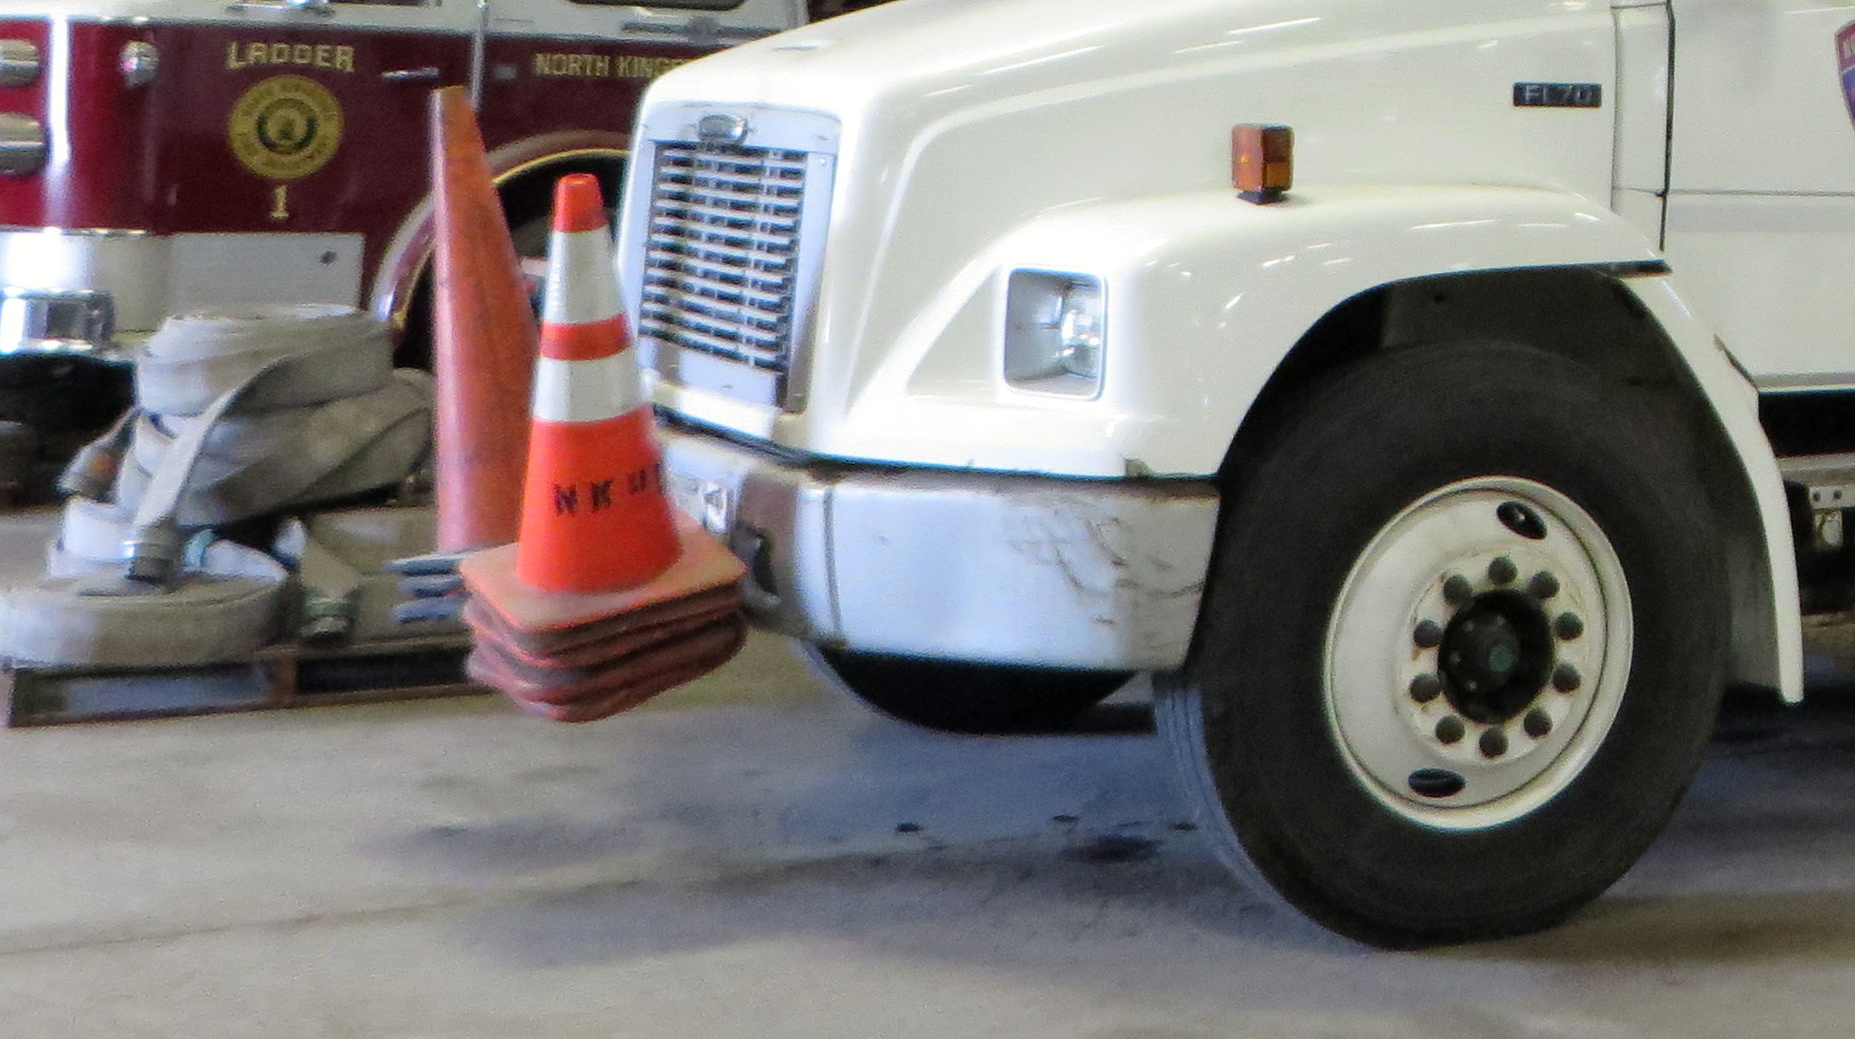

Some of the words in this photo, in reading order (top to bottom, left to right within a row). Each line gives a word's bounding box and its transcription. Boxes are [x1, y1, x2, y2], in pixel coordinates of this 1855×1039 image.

[226, 41, 354, 73] LADDER
[534, 53, 610, 77] NORTH
[269, 185, 289, 219] 1
